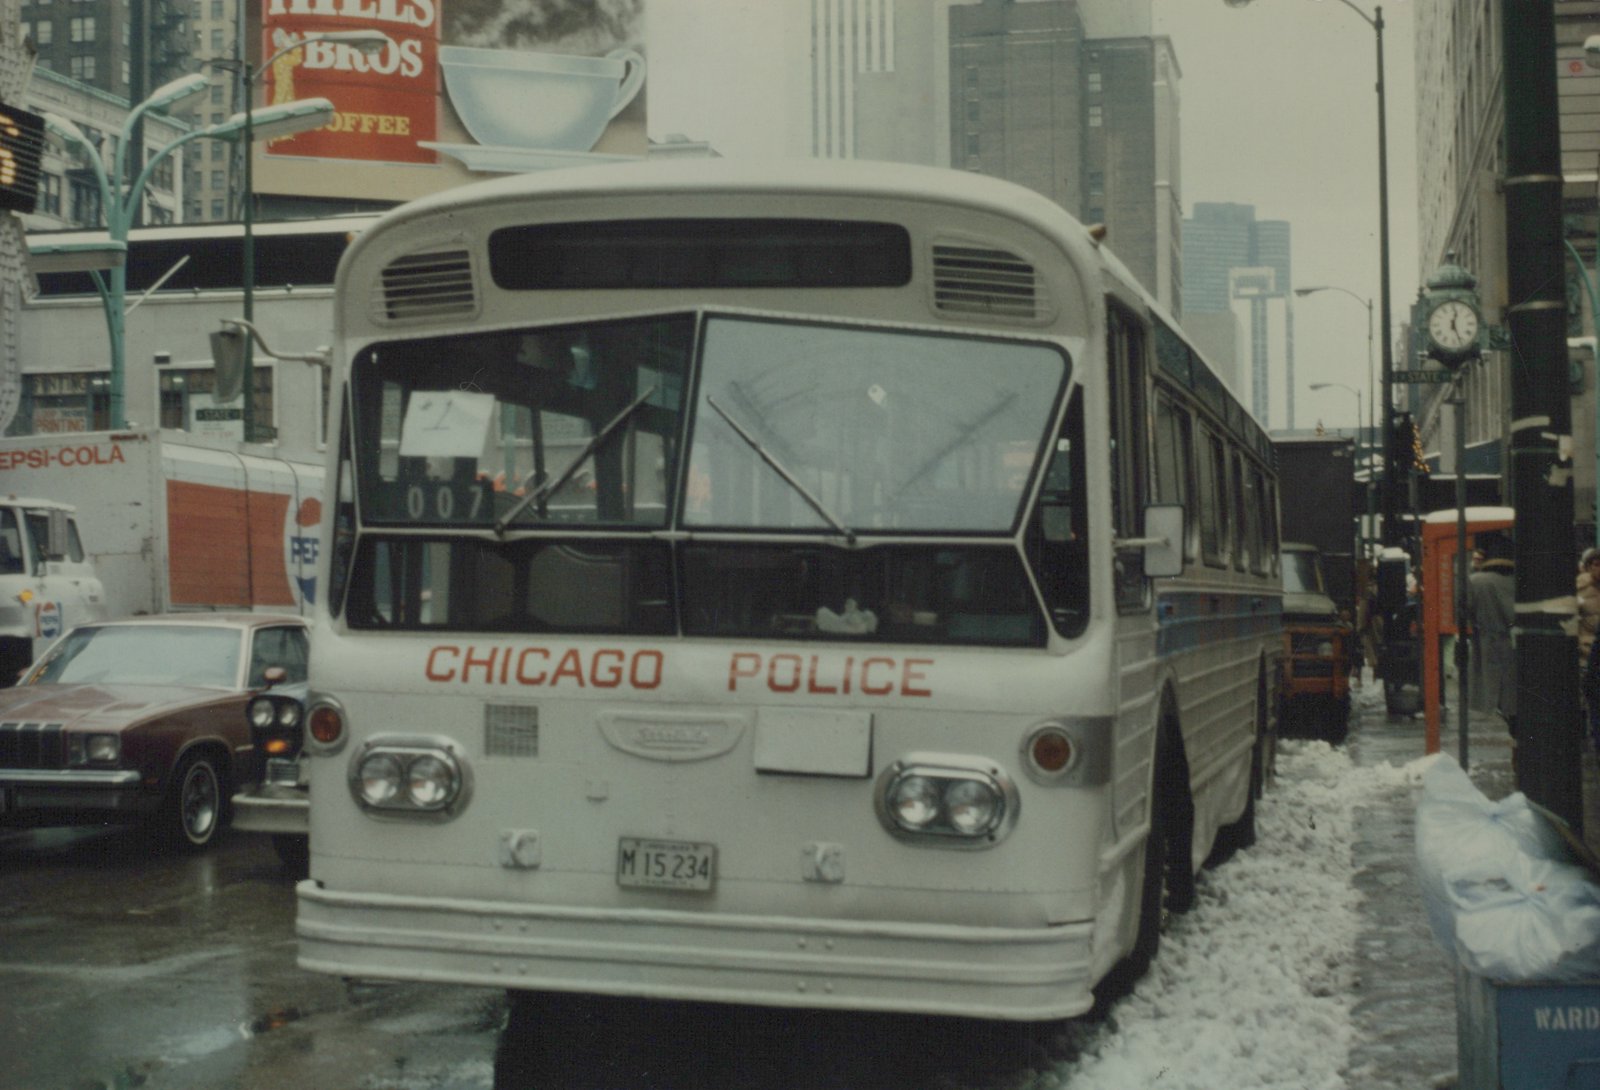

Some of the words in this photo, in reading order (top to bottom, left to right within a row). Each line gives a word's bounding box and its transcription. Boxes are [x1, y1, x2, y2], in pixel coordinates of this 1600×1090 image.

[302, 30, 423, 78] BROS
[315, 112, 411, 136] OFFEE
[425, 645, 664, 690] CHICAGO
[727, 652, 935, 697] POLICE
[621, 848, 636, 876] M
